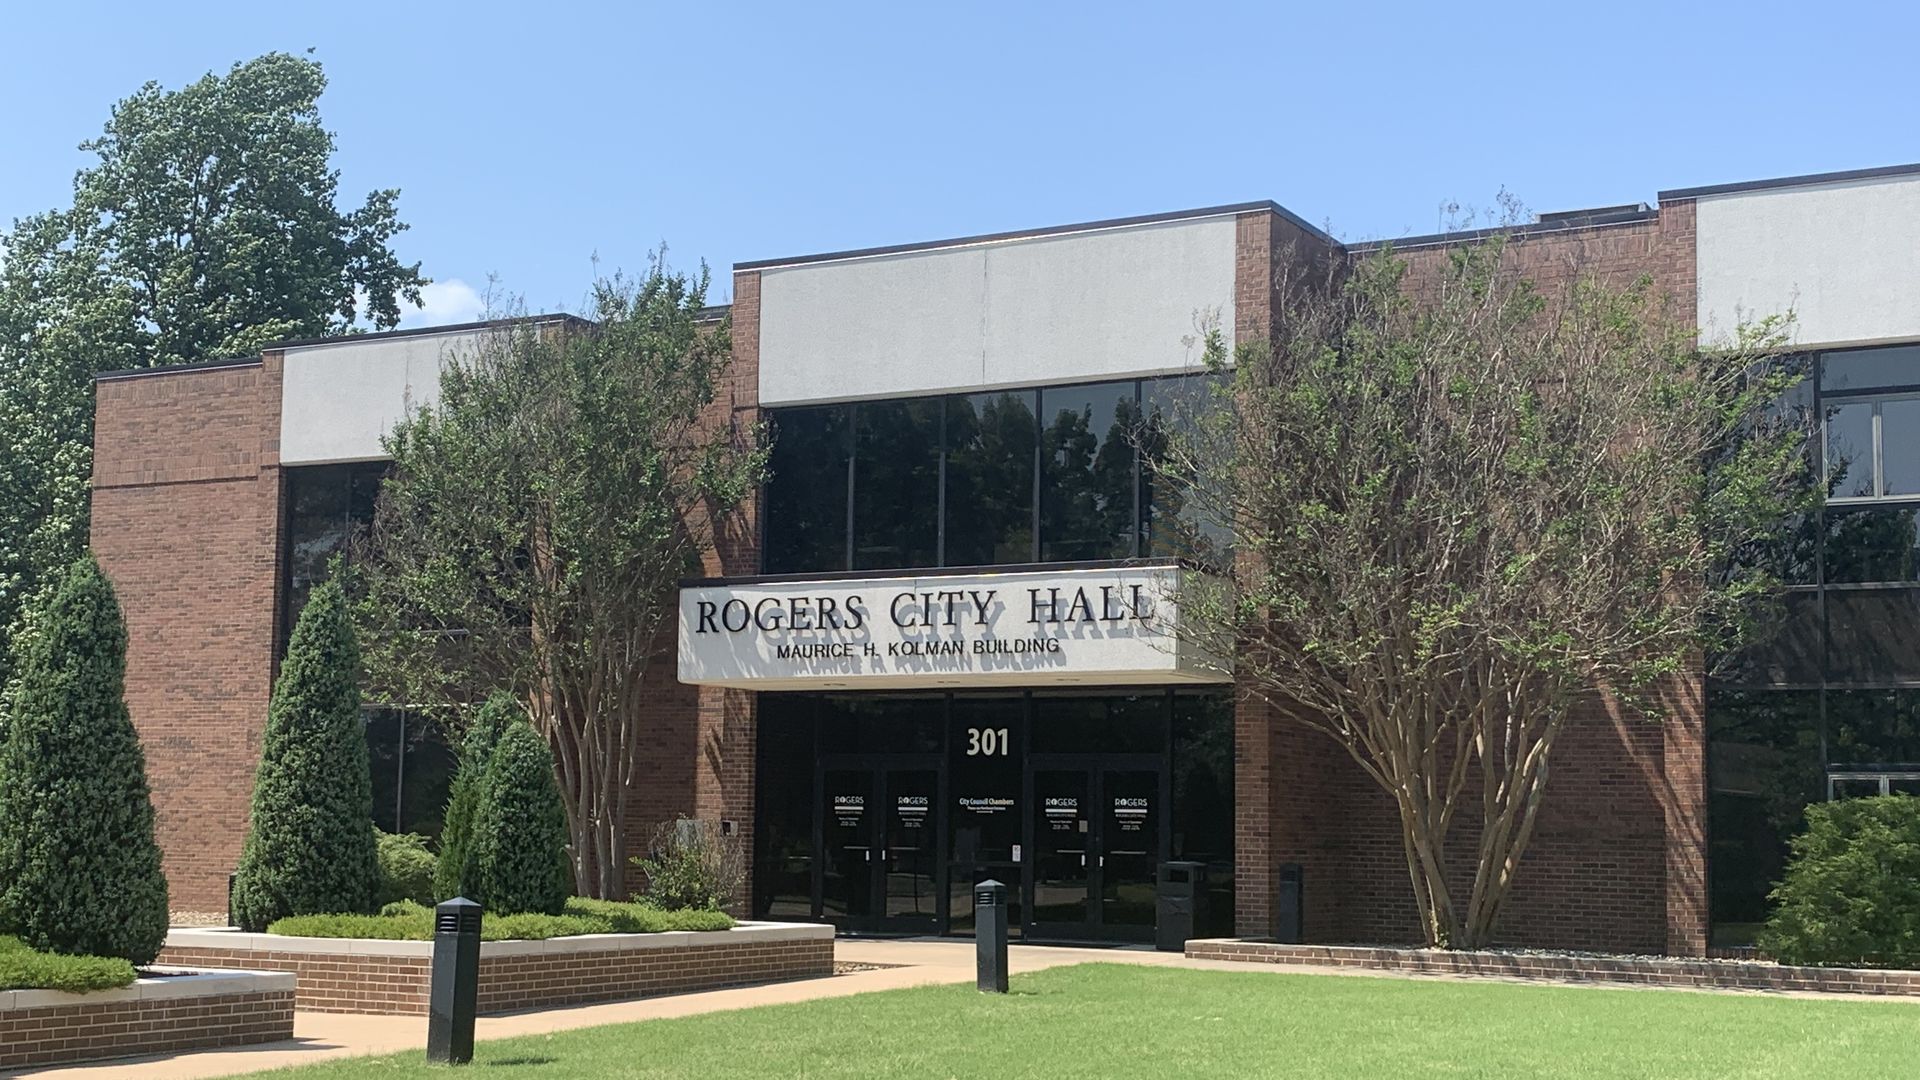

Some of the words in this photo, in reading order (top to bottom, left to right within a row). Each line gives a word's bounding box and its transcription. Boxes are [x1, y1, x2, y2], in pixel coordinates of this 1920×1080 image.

[696, 595, 863, 634] ROGERS
[890, 591, 998, 628] CITY
[1027, 584, 1154, 623] HALL
[777, 642, 854, 659] MAURICE
[864, 641, 880, 657] H.
[888, 640, 964, 657] KOLMAN
[974, 638, 1060, 655] BUILDING
[966, 728, 1008, 756] 301
[834, 796, 864, 804] ROGERS
[898, 796, 928, 804] ROGERS
[959, 798, 969, 806] City
[1045, 798, 1077, 806] ROGERS
[1114, 798, 1148, 806] ROGERS
